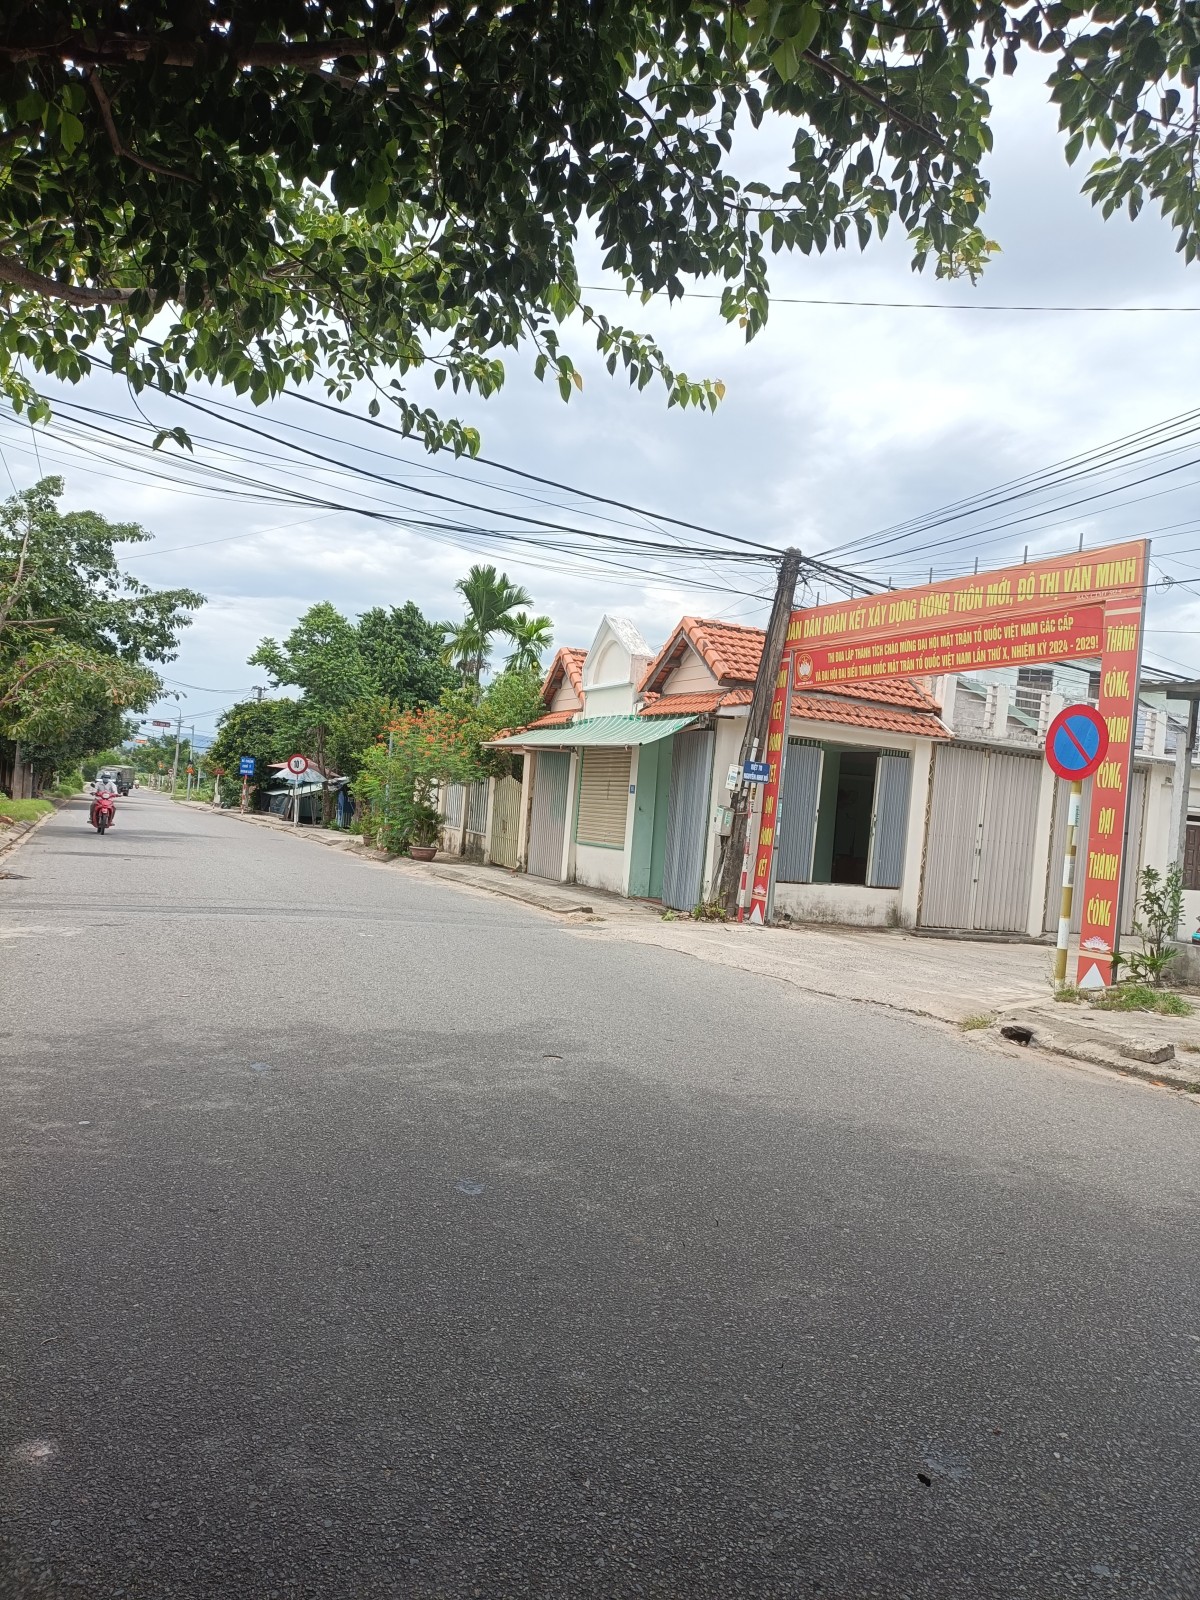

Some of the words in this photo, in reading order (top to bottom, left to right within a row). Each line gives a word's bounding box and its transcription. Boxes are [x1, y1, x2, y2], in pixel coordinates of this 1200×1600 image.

[804, 614, 821, 638] DÂN
[823, 610, 846, 635] ĐOÀN
[849, 603, 866, 631] KẾT
[867, 602, 887, 627] XÂY
[888, 600, 917, 627] DỰNG
[919, 593, 950, 619] NÔNG
[953, 584, 983, 612] THÔN
[986, 577, 1013, 608] MỚI,
[1017, 571, 1036, 601] ĐÔ
[1039, 571, 1060, 600] THỊ
[1064, 562, 1091, 593] VĂN
[1095, 557, 1136, 588] MINH
[845, 647, 855, 663] LẬP
[855, 646, 871, 660] THÀNH
[872, 643, 883, 657] TÍCH
[884, 640, 899, 655] CHÀO
[900, 638, 916, 653] MỪNG
[917, 638, 928, 653] ĐẠI
[928, 634, 939, 651] HỘI
[955, 630, 972, 647] TRẬN
[973, 624, 982, 643] TỔ
[983, 623, 1002, 643] QUỐC
[1003, 622, 1019, 640] VIỆT
[1020, 622, 1038, 637] NAM
[1040, 617, 1056, 634] CÁC
[1057, 612, 1074, 632] CẤP
[1106, 621, 1137, 652] THÀNH
[872, 659, 887, 676] QUỐC
[900, 657, 915, 673] TRẬN
[916, 653, 924, 670] TỔ
[924, 651, 940, 670] QUỐC
[941, 651, 955, 668] VIỆT
[956, 651, 972, 665] NAM
[973, 645, 986, 663] LẦN
[987, 645, 1001, 661] THỨ
[1002, 646, 1010, 660] X,
[1011, 641, 1036, 660] NHIỆM
[1037, 639, 1047, 656] KỲ
[1049, 639, 1068, 654] 2024
[1075, 635, 1099, 651] 2029!
[1103, 666, 1130, 700] CÔNG,
[1103, 711, 1130, 743] HÀNH
[1096, 756, 1123, 792] CÔNG,
[1098, 807, 1116, 839] ĐẠI
[1088, 848, 1119, 881] THÀNH
[1087, 893, 1112, 927] CÔNG
